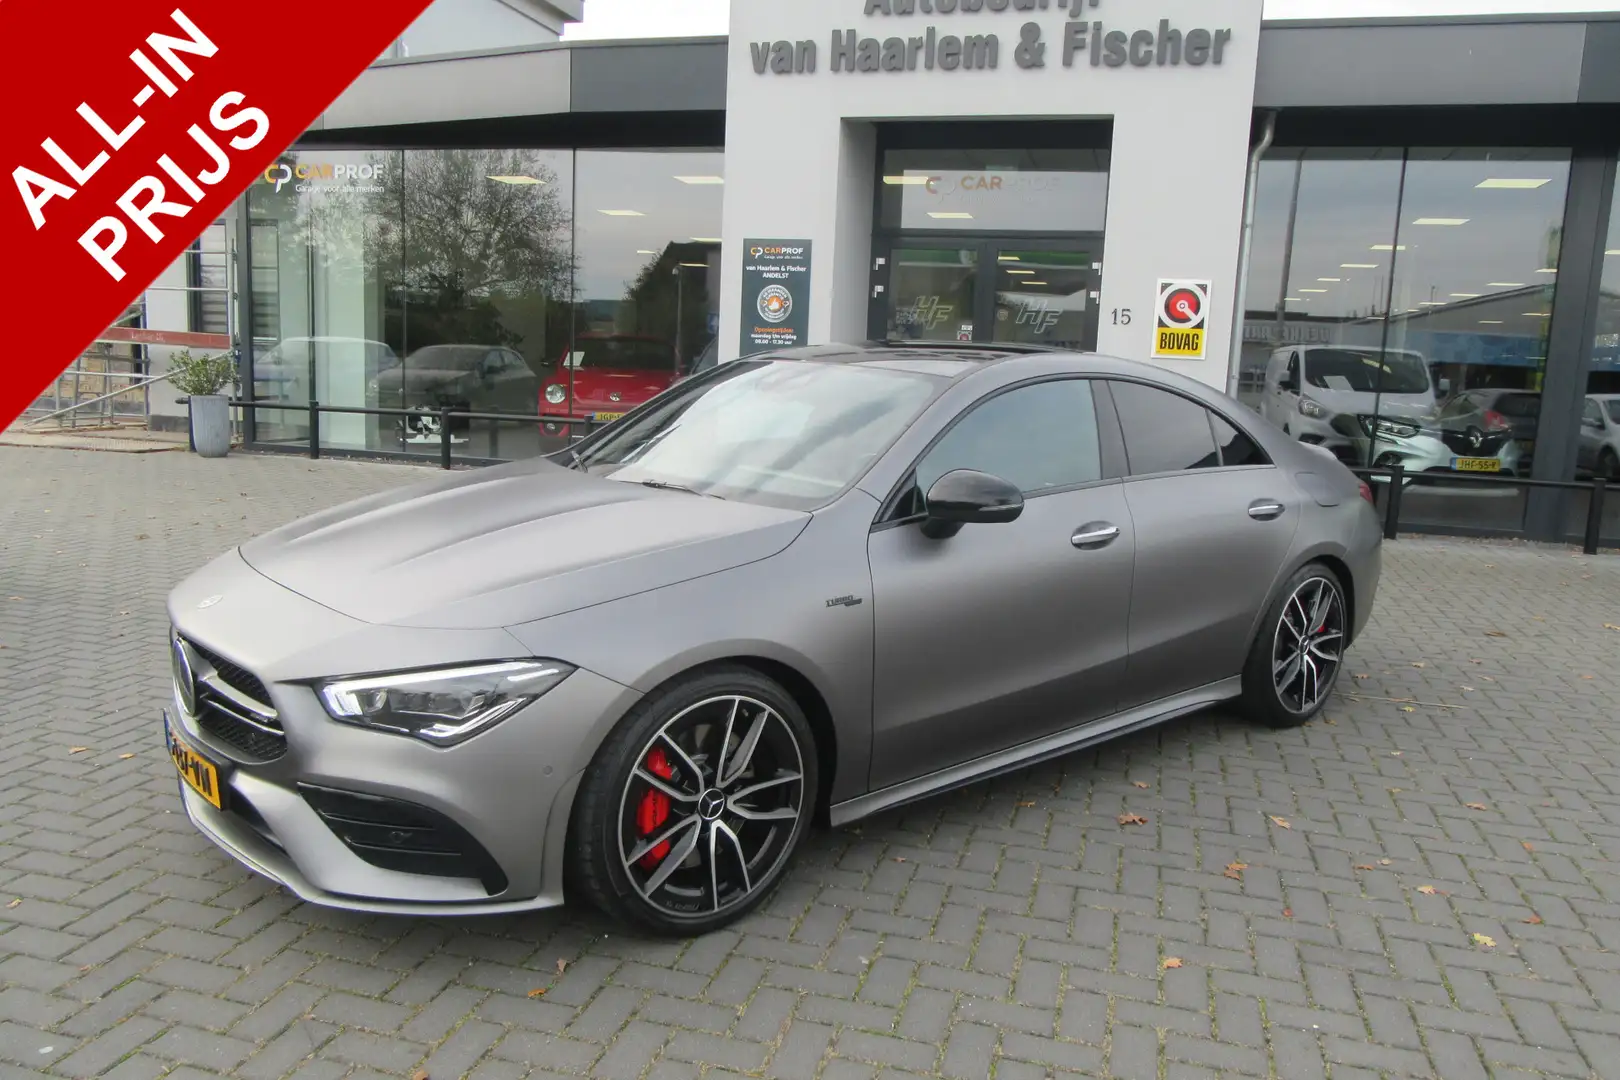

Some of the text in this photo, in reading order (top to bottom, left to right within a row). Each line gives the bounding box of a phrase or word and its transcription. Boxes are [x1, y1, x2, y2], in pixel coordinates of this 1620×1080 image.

[750, 18, 1232, 74] van Haarlem & Fischer
[295, 163, 384, 179] CARPROF
[356, 184, 384, 193] merken
[1111, 308, 1132, 325] 15
[1159, 332, 1200, 351] BOVAG
